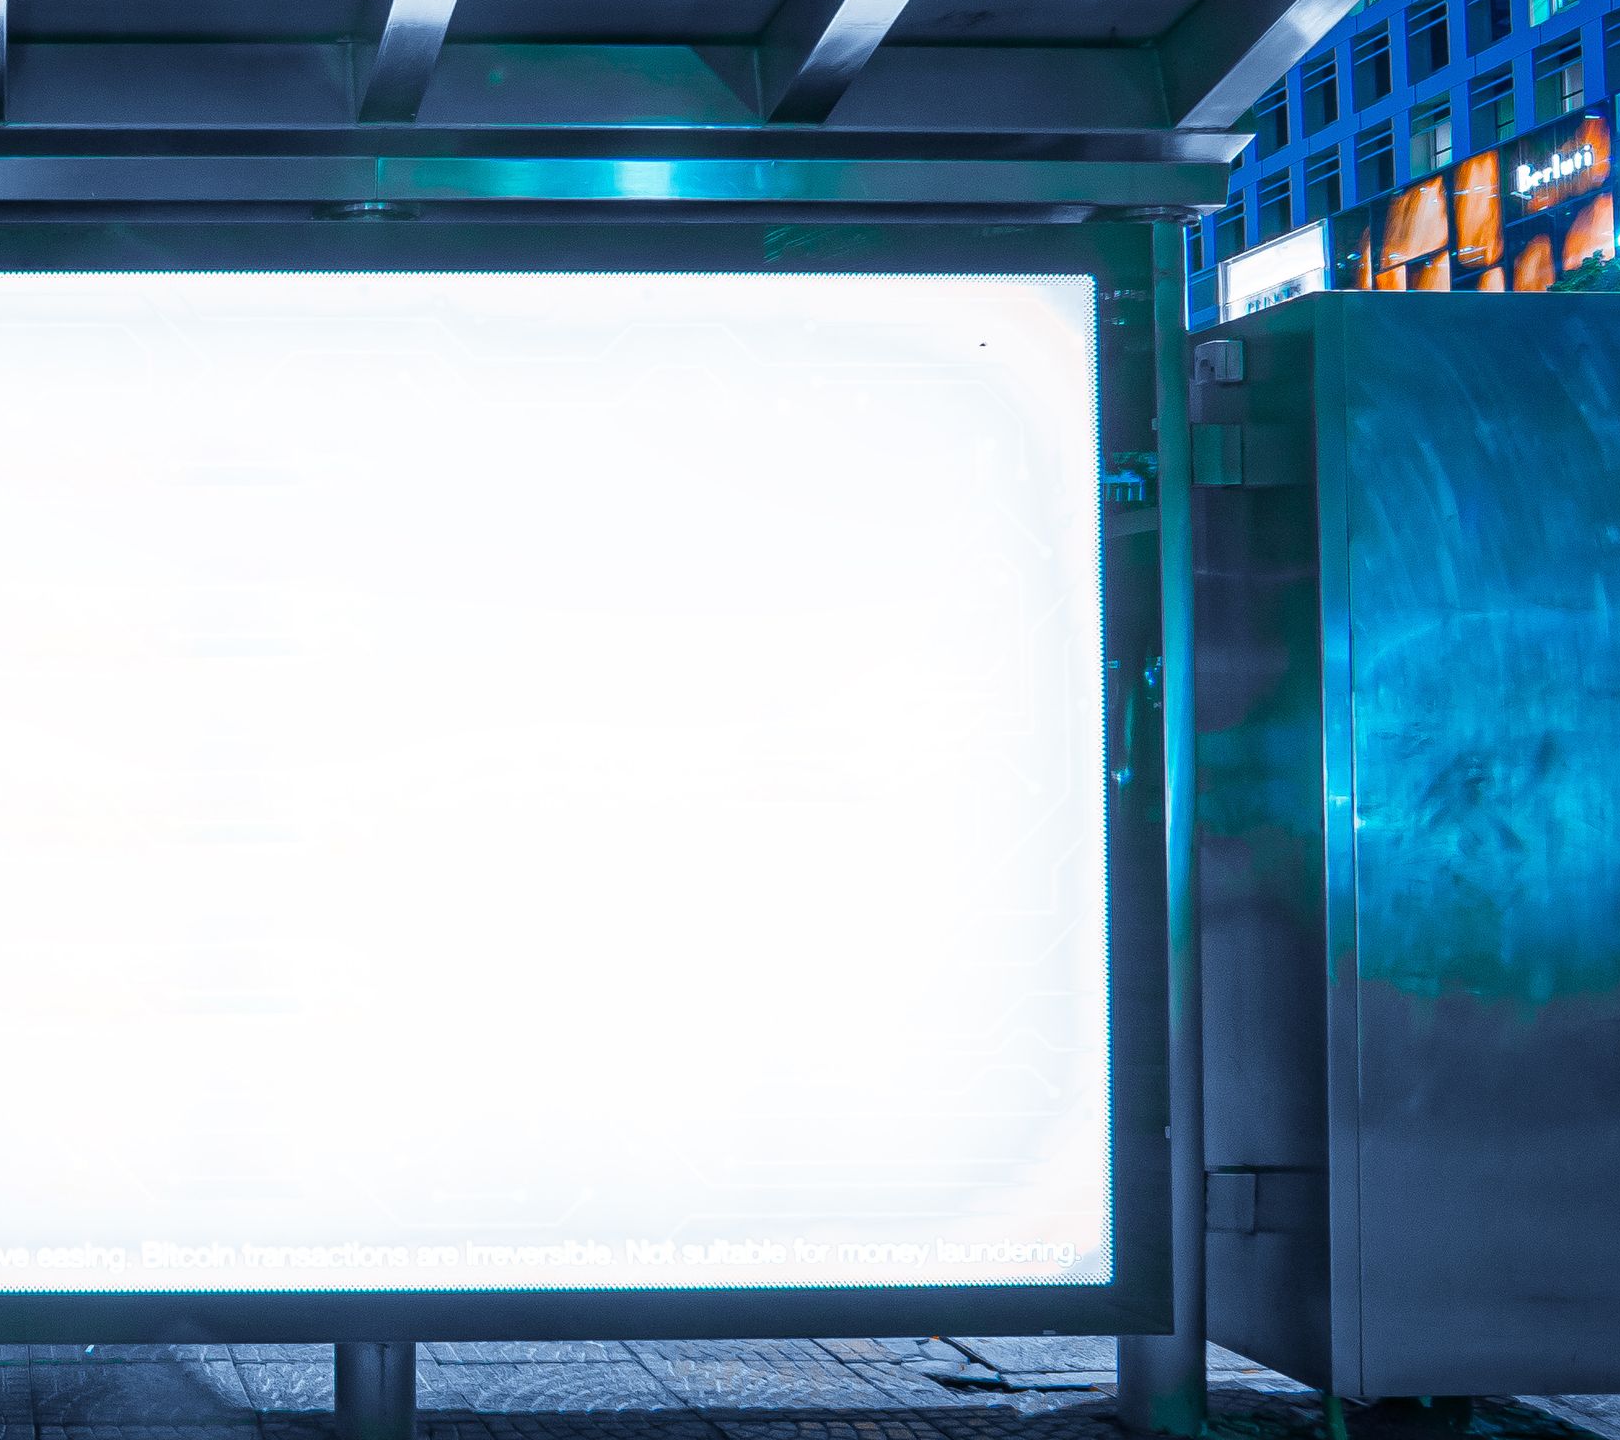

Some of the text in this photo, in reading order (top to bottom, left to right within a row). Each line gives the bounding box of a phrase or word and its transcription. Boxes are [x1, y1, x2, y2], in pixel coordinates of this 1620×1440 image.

[141, 1241, 236, 1270] Bitcoin
[417, 1246, 459, 1269] are
[626, 1239, 676, 1266] Not
[682, 1239, 787, 1266] suitable
[792, 1238, 833, 1266] for
[837, 1244, 930, 1271] money
[935, 1237, 1082, 1271] laundering.
